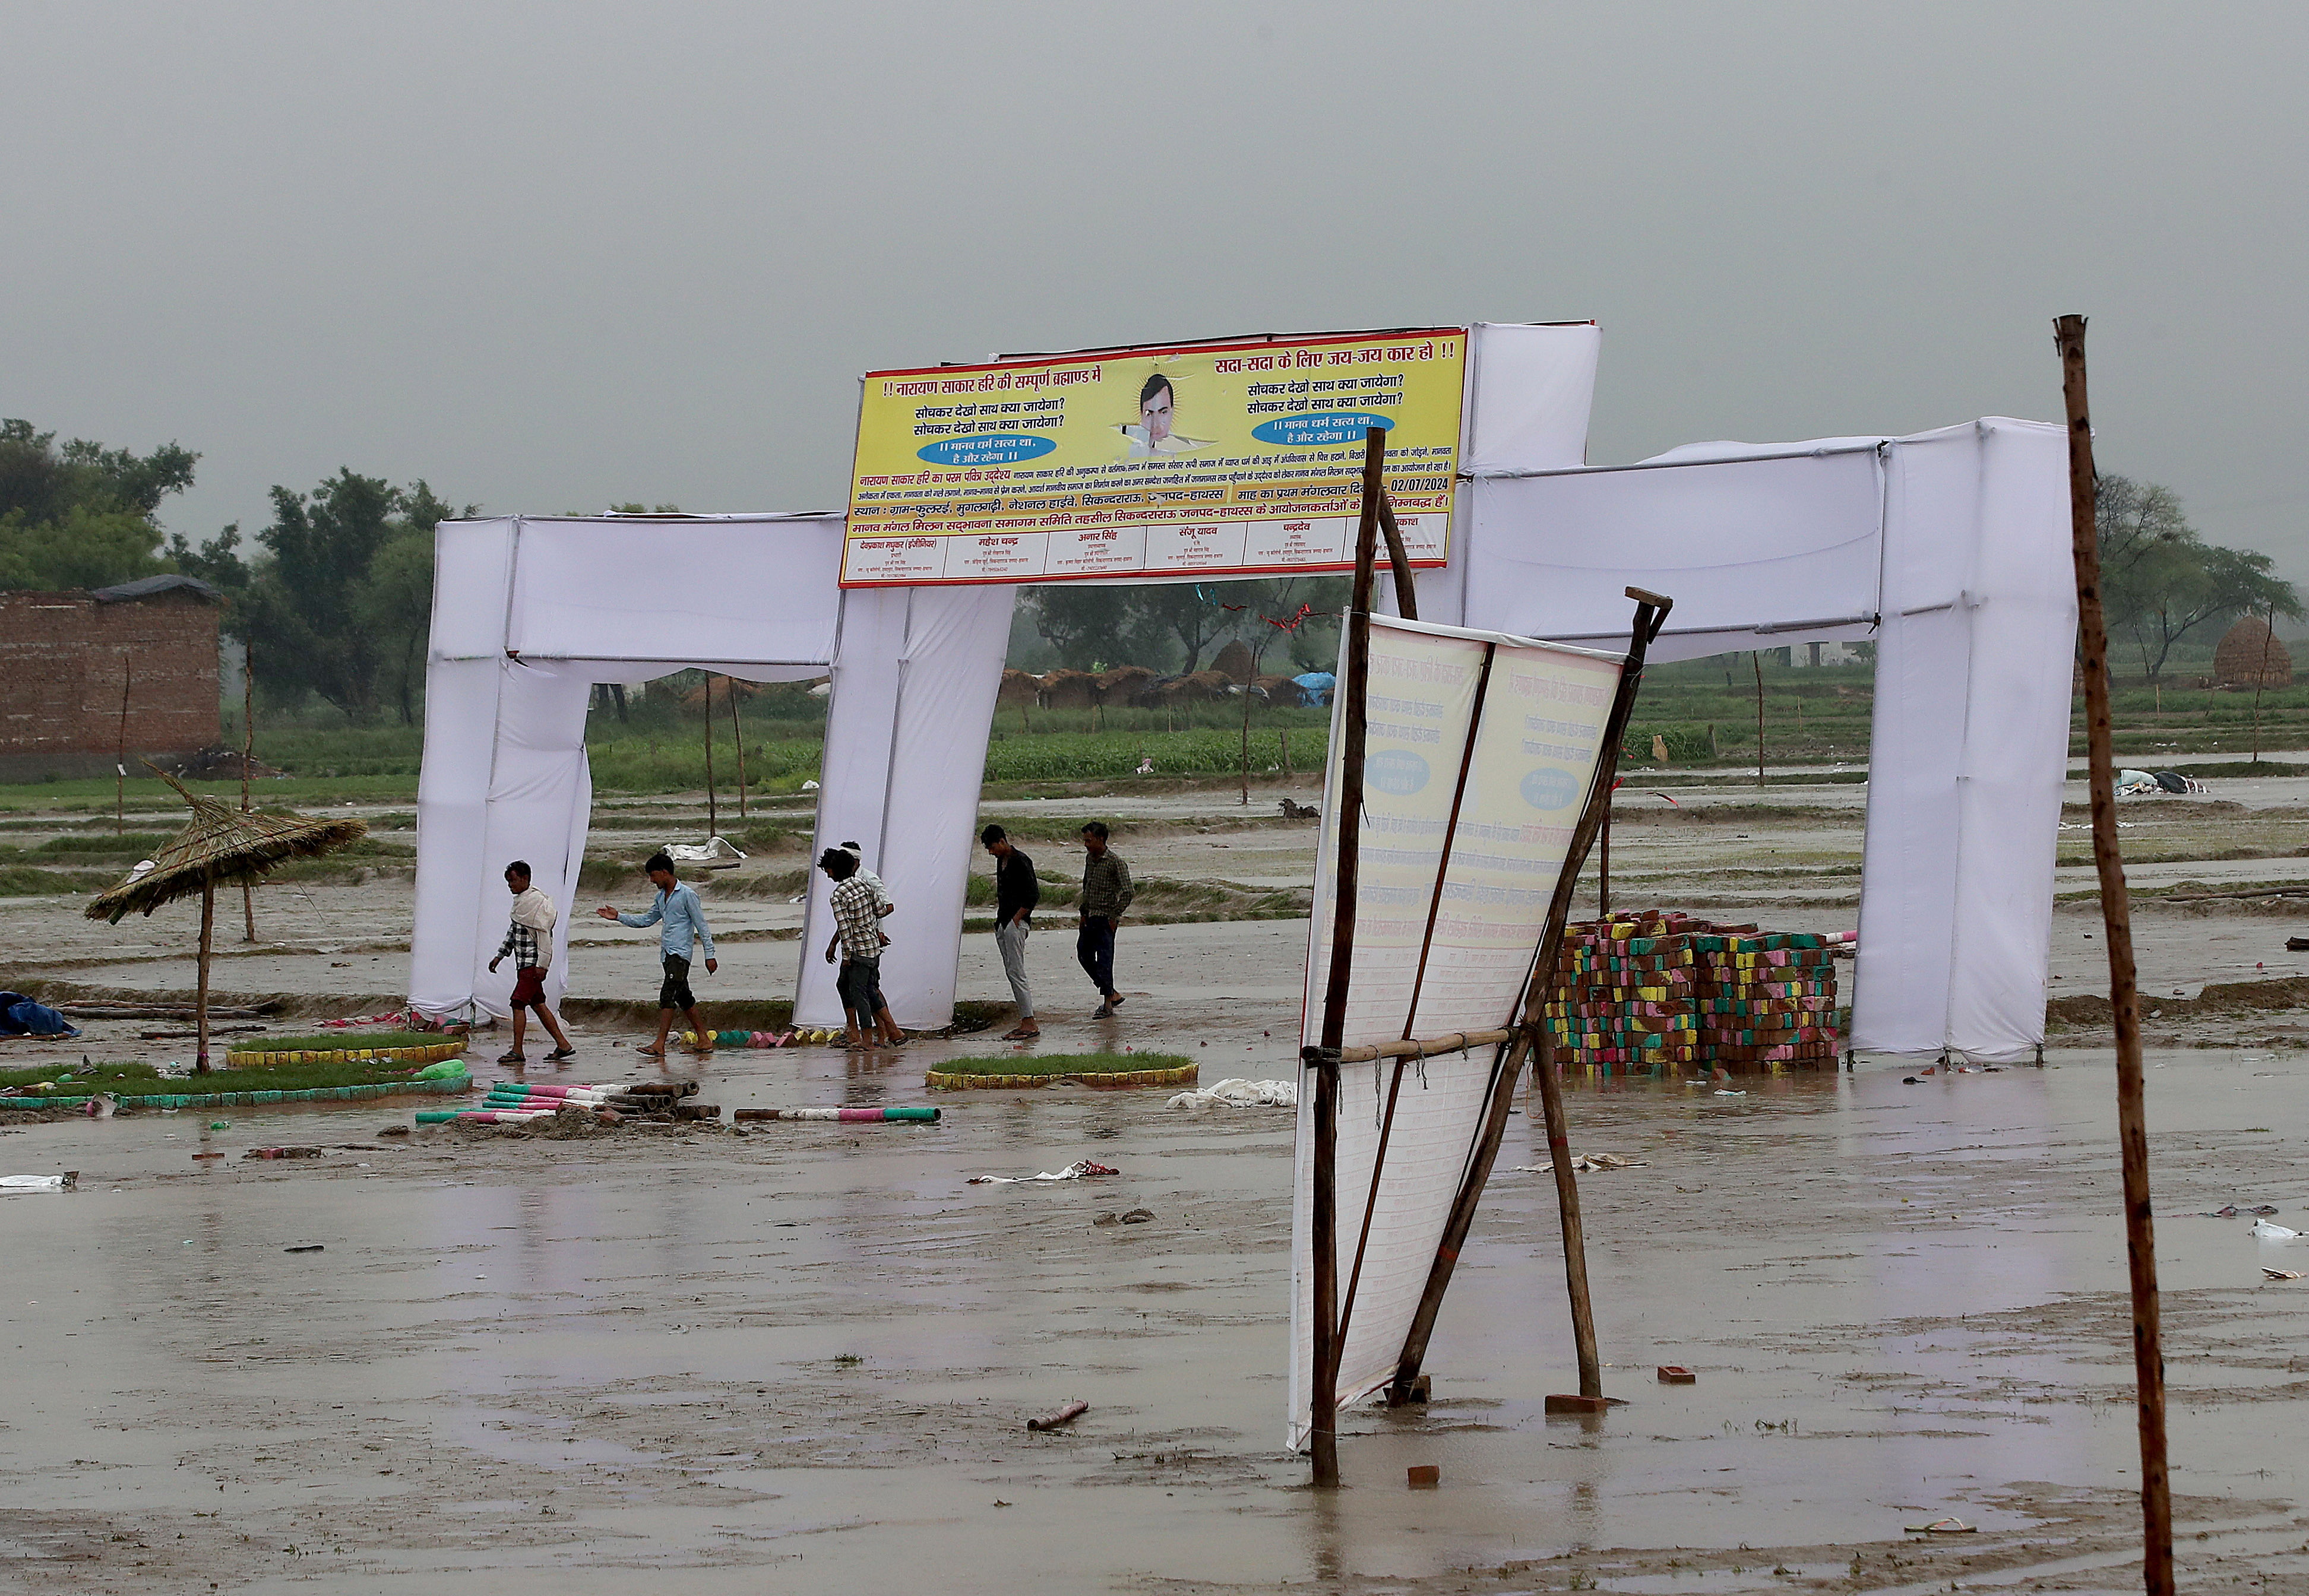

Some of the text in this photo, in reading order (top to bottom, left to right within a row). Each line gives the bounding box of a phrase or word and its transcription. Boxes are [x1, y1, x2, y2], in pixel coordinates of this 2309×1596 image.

[1214, 356, 1274, 373] सदा-सदा
[1277, 350, 1292, 369] के
[1295, 349, 1324, 368] लिए
[1327, 348, 1384, 366] जय-जय
[1386, 346, 1416, 362] कार
[1418, 340, 1434, 360] हो
[896, 381, 939, 397] नारायण
[940, 379, 976, 394] साकार
[977, 373, 996, 392] हरि
[997, 372, 1013, 390] की
[1091, 364, 1102, 382] में
[1247, 372, 1405, 397] सोचकर देखो साथ क्या जायेगा?
[915, 397, 1065, 419] सोचकर देखो साथ क्या जायेगा?
[1247, 391, 1403, 414] सोचकर देखो साथ क्या जायेगा?
[913, 414, 1065, 436] सोचकर देखो साथ क्या जायेगा?
[1284, 416, 1374, 430] मानव धर्म सत्य था,
[950, 437, 1036, 451] मानव धर्म सत्य था,
[1286, 430, 1343, 444] है और रहेगा
[859, 475, 890, 487] नारायण
[890, 474, 916, 486] साकार
[916, 469, 931, 486] हरि
[931, 473, 944, 484] का
[945, 472, 963, 483] परम
[964, 467, 983, 483] पवित्र
[1054, 466, 1065, 479] हरि
[1065, 466, 1075, 477] की
[1100, 464, 1107, 475] से
[1198, 460, 1217, 469] समाज
[1217, 456, 1225, 467] में
[1251, 454, 1261, 466] की
[1308, 451, 1316, 463] से
[1399, 446, 1409, 457] को
[953, 450, 1004, 464] है और रहेगा
[1237, 477, 1449, 501] माह का प्रथम मंगलवार 02/07/2024
[852, 523, 882, 533] मानव
[882, 520, 912, 532] मंगल
[912, 518, 944, 531] मिलन
[994, 518, 1038, 529] समागम
[1039, 512, 1073, 527] समिति
[1074, 510, 1114, 525] तहसील
[1114, 508, 1178, 522] सिकन्दराराऊ
[1255, 502, 1268, 515] के
[1349, 497, 1362, 511] के
[1434, 493, 1449, 508] हैं।
[853, 506, 881, 517] स्थान
[889, 500, 953, 518] ग्राम-फुलरई,
[1008, 498, 1048, 511] नेशनल
[1048, 494, 1078, 509] हाईवे,
[1077, 528, 1118, 542] अनार सिंह
[1178, 525, 1219, 540] संजू यादव
[1283, 520, 1311, 533] चन्द्रदेव
[978, 535, 1020, 547] महेश चन्द्र
